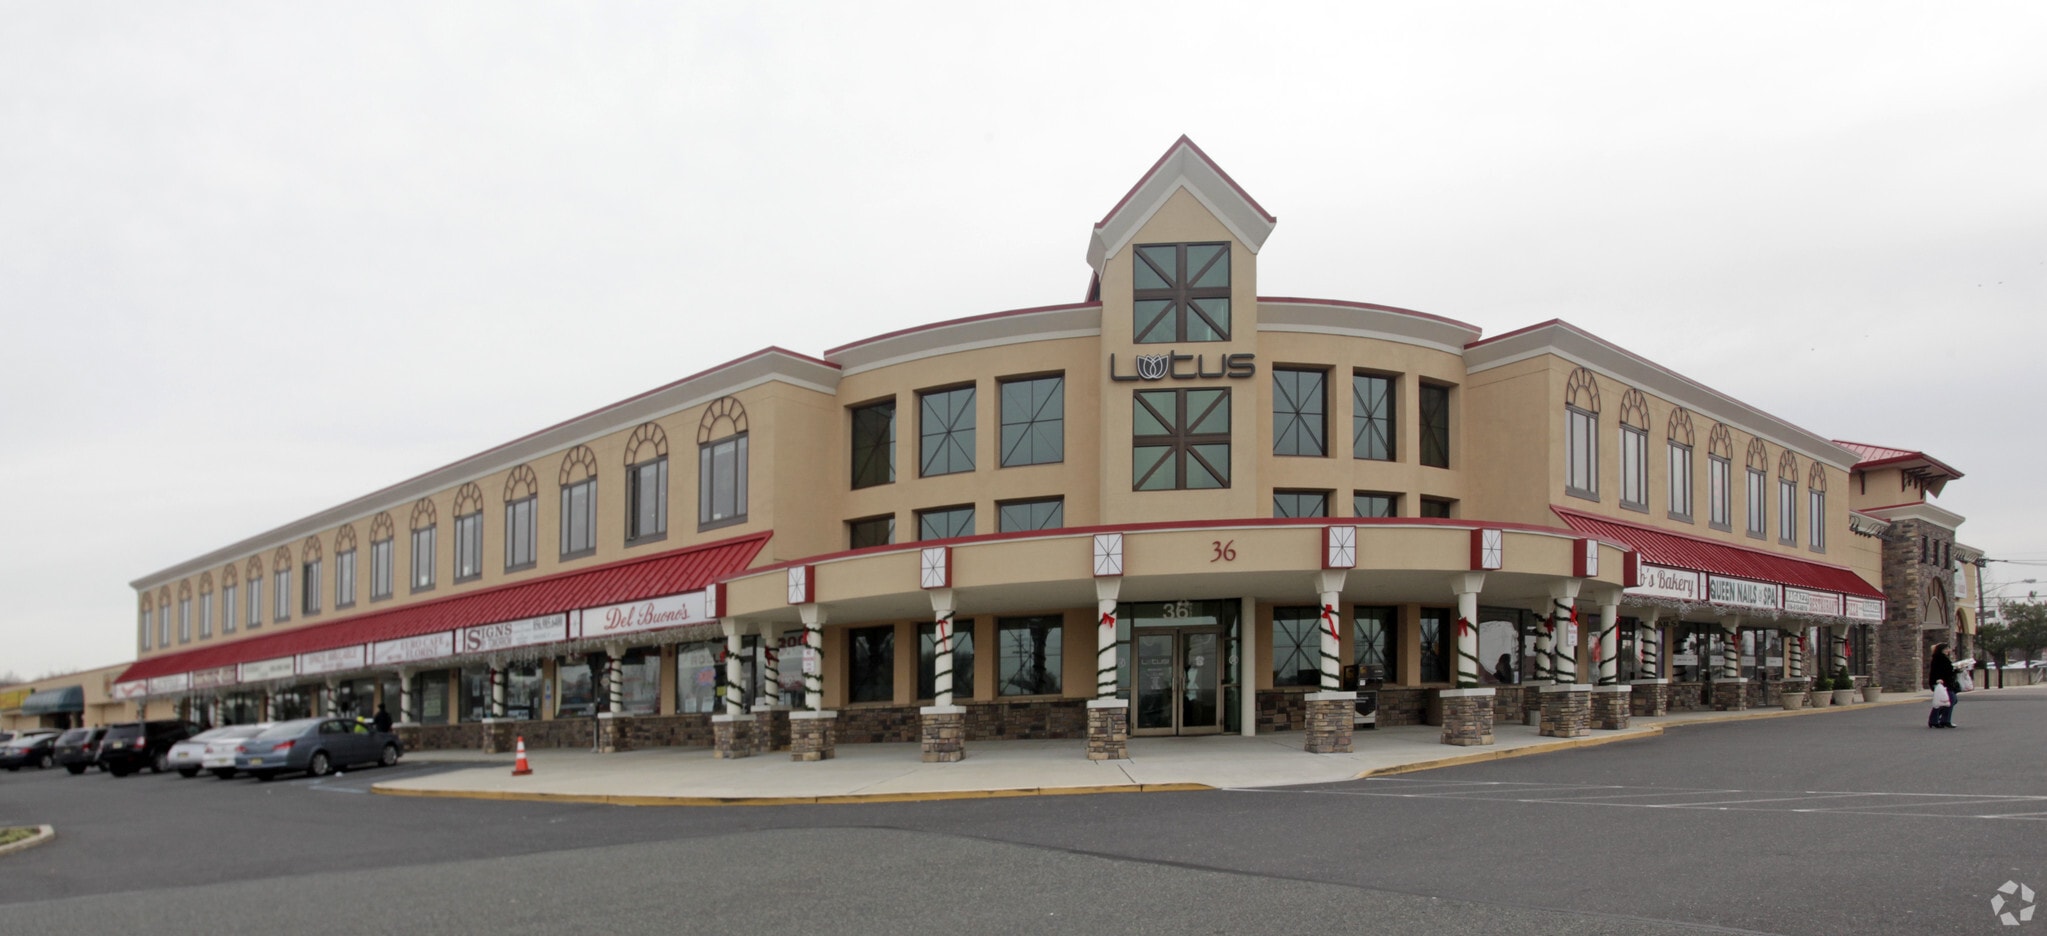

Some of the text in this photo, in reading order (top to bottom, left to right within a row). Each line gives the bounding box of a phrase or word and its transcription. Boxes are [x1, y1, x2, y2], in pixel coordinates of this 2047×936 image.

[1210, 539, 1237, 563] 36
[1657, 570, 1694, 598] Bakery
[1710, 579, 1735, 602] QUEEN
[1737, 583, 1757, 604] NAILS
[1763, 586, 1776, 606] SPA
[604, 602, 690, 630] Del Buono's
[1162, 603, 1189, 619] 36
[467, 623, 512, 651] SIGNS
